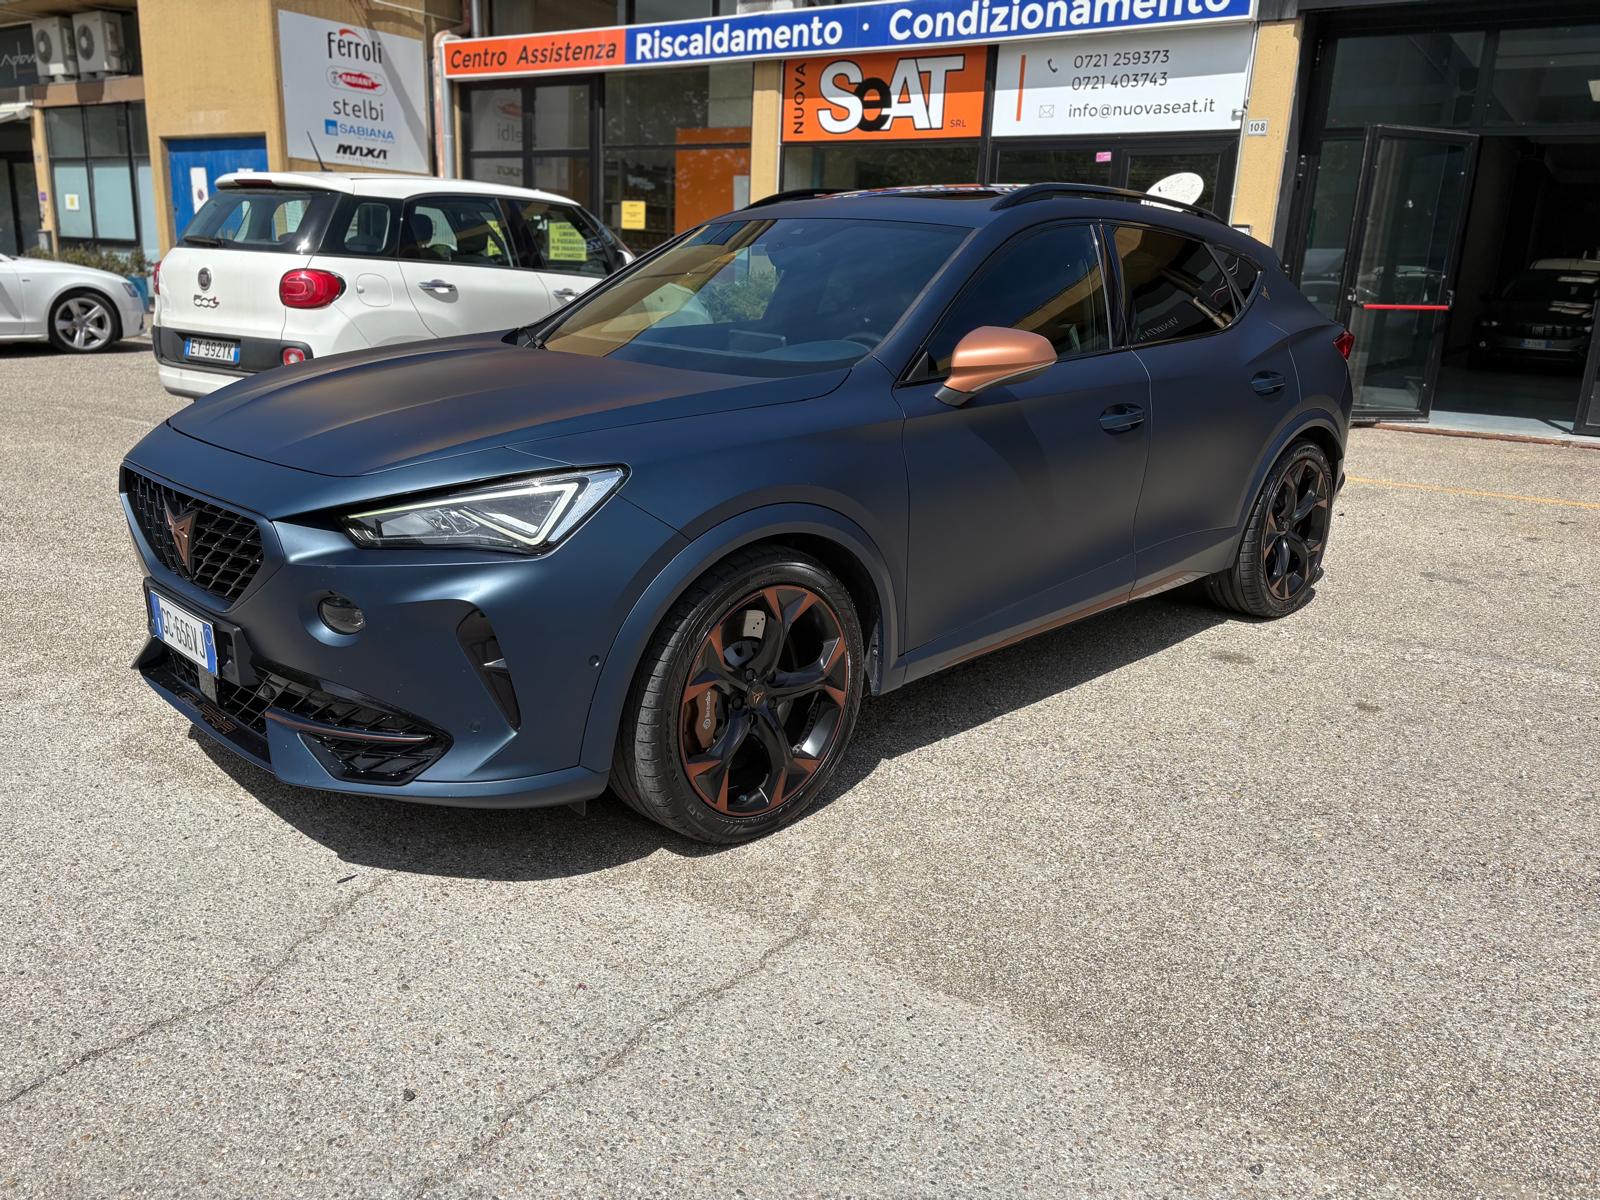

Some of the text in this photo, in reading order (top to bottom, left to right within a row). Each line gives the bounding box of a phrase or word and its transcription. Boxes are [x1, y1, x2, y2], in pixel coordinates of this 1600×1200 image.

[327, 30, 383, 64] Ferroli
[634, 15, 843, 61] Riscaldamento
[450, 42, 617, 69] Centro Assistenza
[1073, 49, 1170, 69] 0721 259373
[1071, 71, 1168, 91] 0721 403743
[793, 62, 807, 134] NUOVA
[1068, 97, 1216, 119] info@nuovaseat.it
[333, 98, 384, 122] stelbi
[339, 123, 394, 141] SABIANA
[949, 119, 967, 128] SRL
[1249, 122, 1266, 132] 108
[336, 143, 388, 160] MAXA
